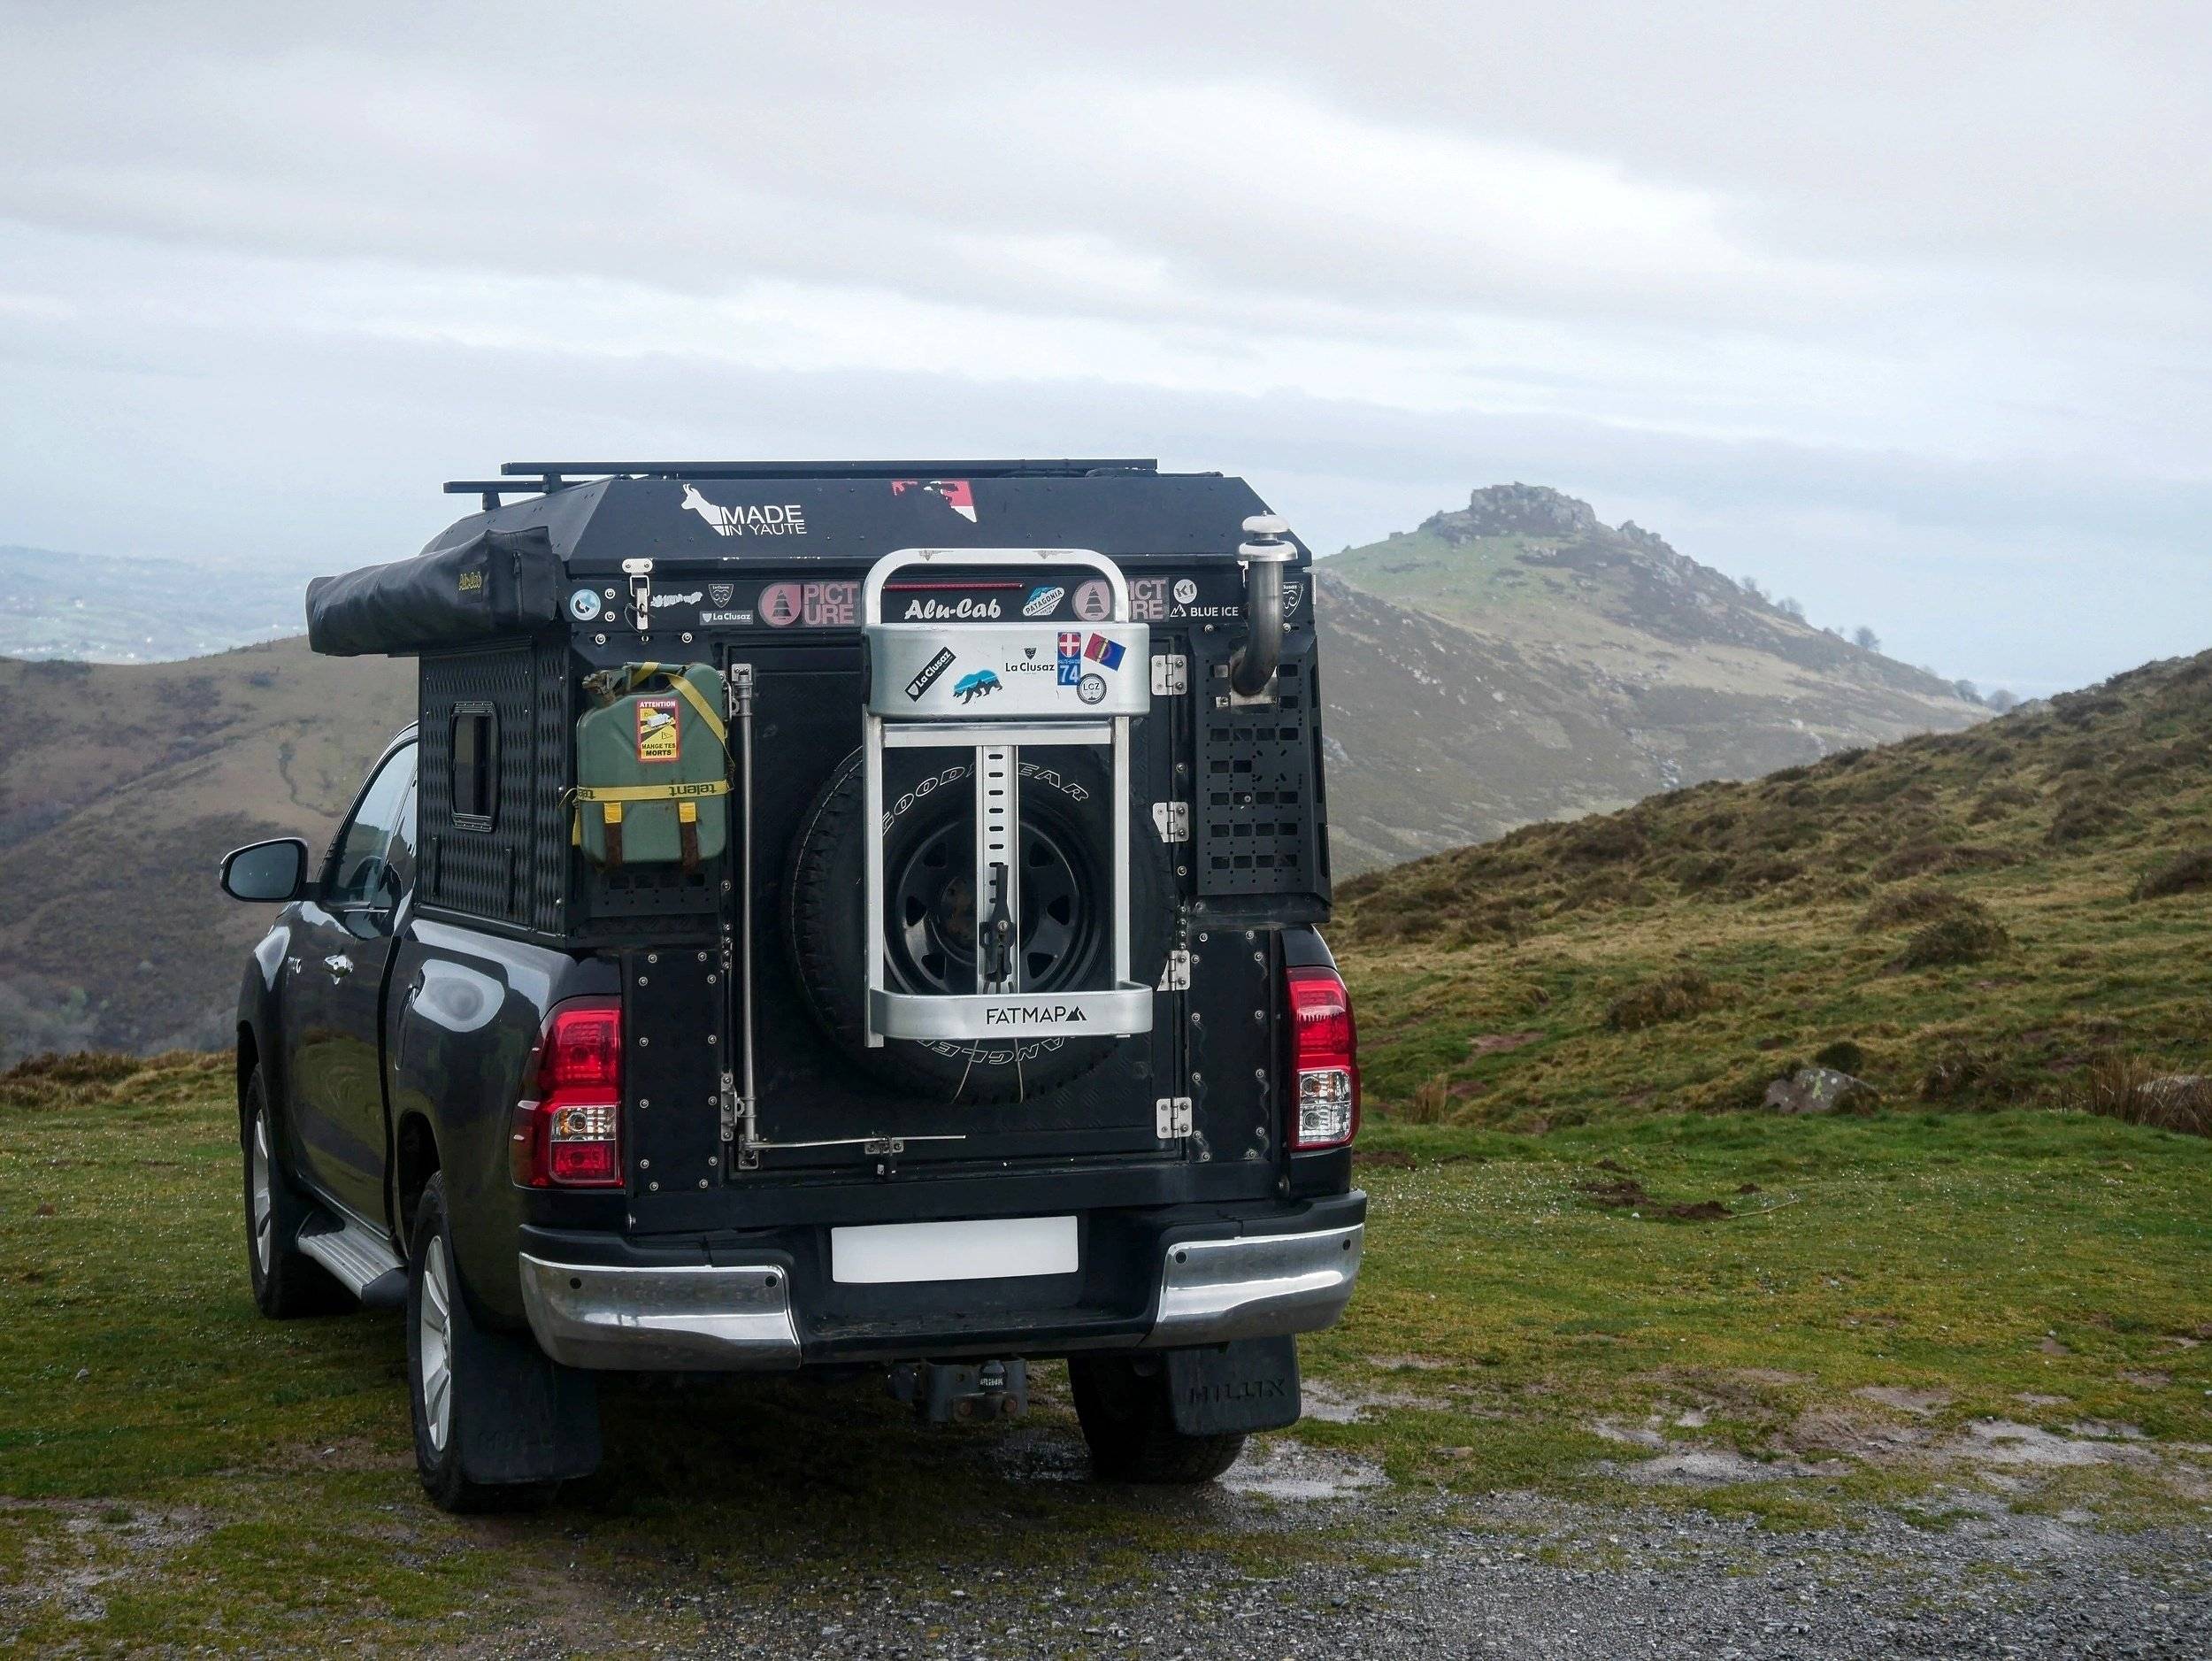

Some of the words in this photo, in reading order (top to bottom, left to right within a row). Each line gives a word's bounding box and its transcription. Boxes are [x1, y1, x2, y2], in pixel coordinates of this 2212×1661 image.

[720, 504, 804, 524] MADE
[725, 524, 742, 536] IN
[749, 523, 808, 535] YAUTE
[803, 583, 858, 604] PICT
[1126, 580, 1166, 600] ICT
[904, 598, 1002, 619] Alu-Cab
[1025, 589, 1063, 613] PATAGONIA
[803, 603, 855, 625] URE
[1190, 607, 1218, 617] BLUE
[1221, 606, 1239, 617] ICE
[915, 675, 928, 688] La
[925, 651, 951, 677] Clusaz
[1005, 663, 1018, 672] La
[1019, 662, 1056, 672] Clusaz
[1060, 665, 1079, 683] 74
[1083, 682, 1100, 691] LCZ
[669, 783, 717, 797] telent
[882, 760, 1089, 836] GOODEAR
[987, 1006, 1066, 1025] FATMAP
